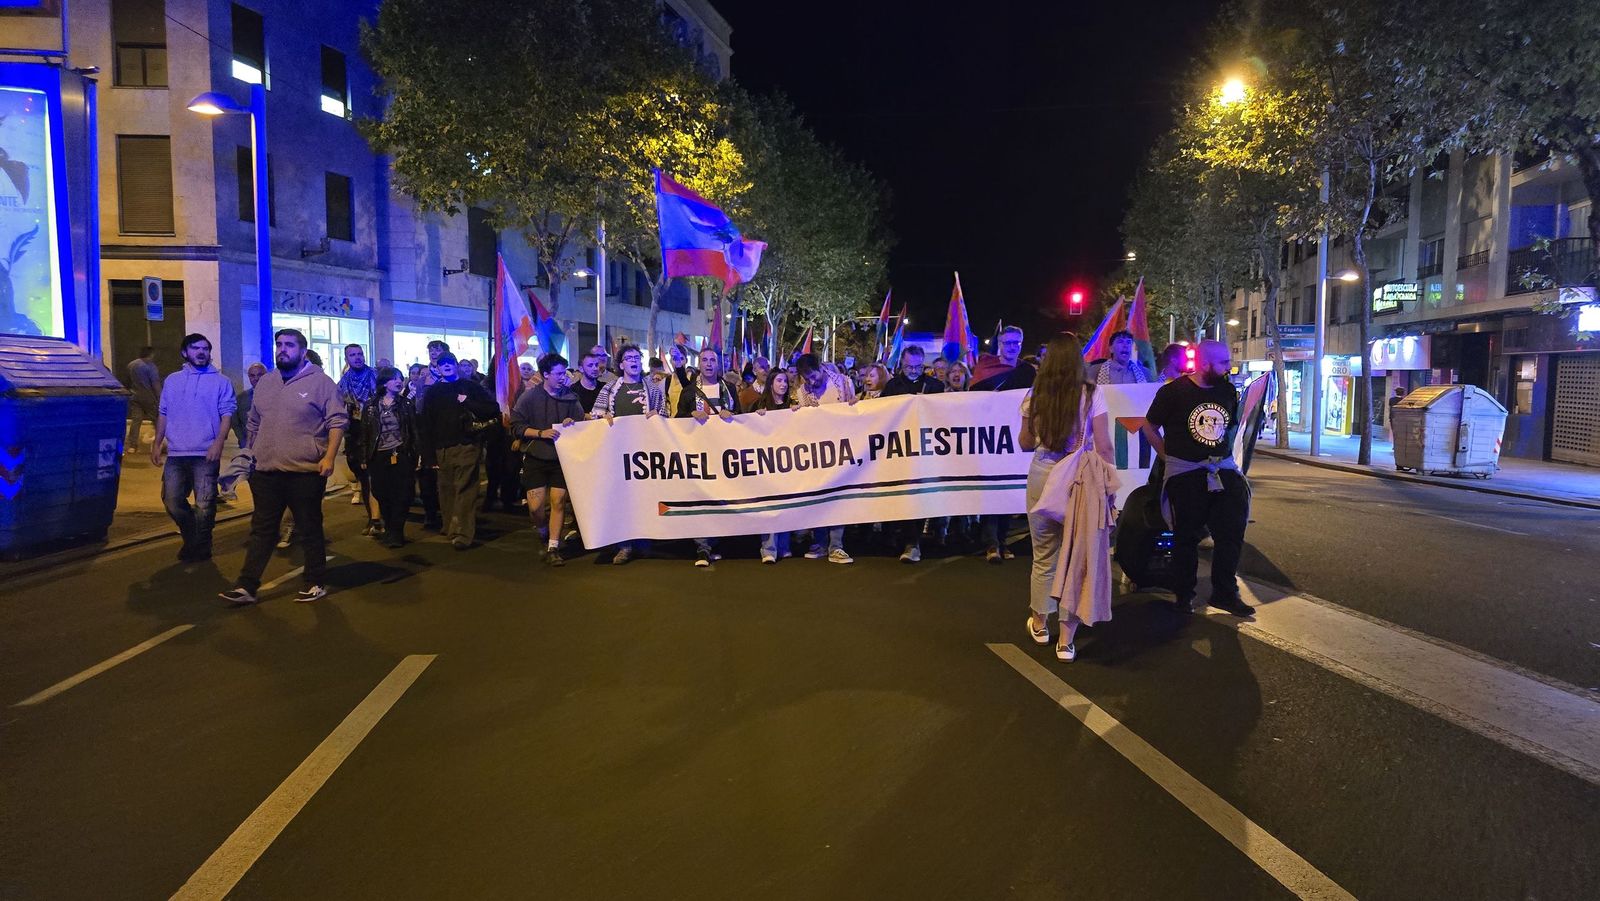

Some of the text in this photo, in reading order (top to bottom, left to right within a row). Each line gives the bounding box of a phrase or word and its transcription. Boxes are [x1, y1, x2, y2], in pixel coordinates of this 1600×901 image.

[1331, 366, 1348, 375] ORO
[623, 424, 1015, 481] ISRAEL GENOCIDA, PALESTINA
